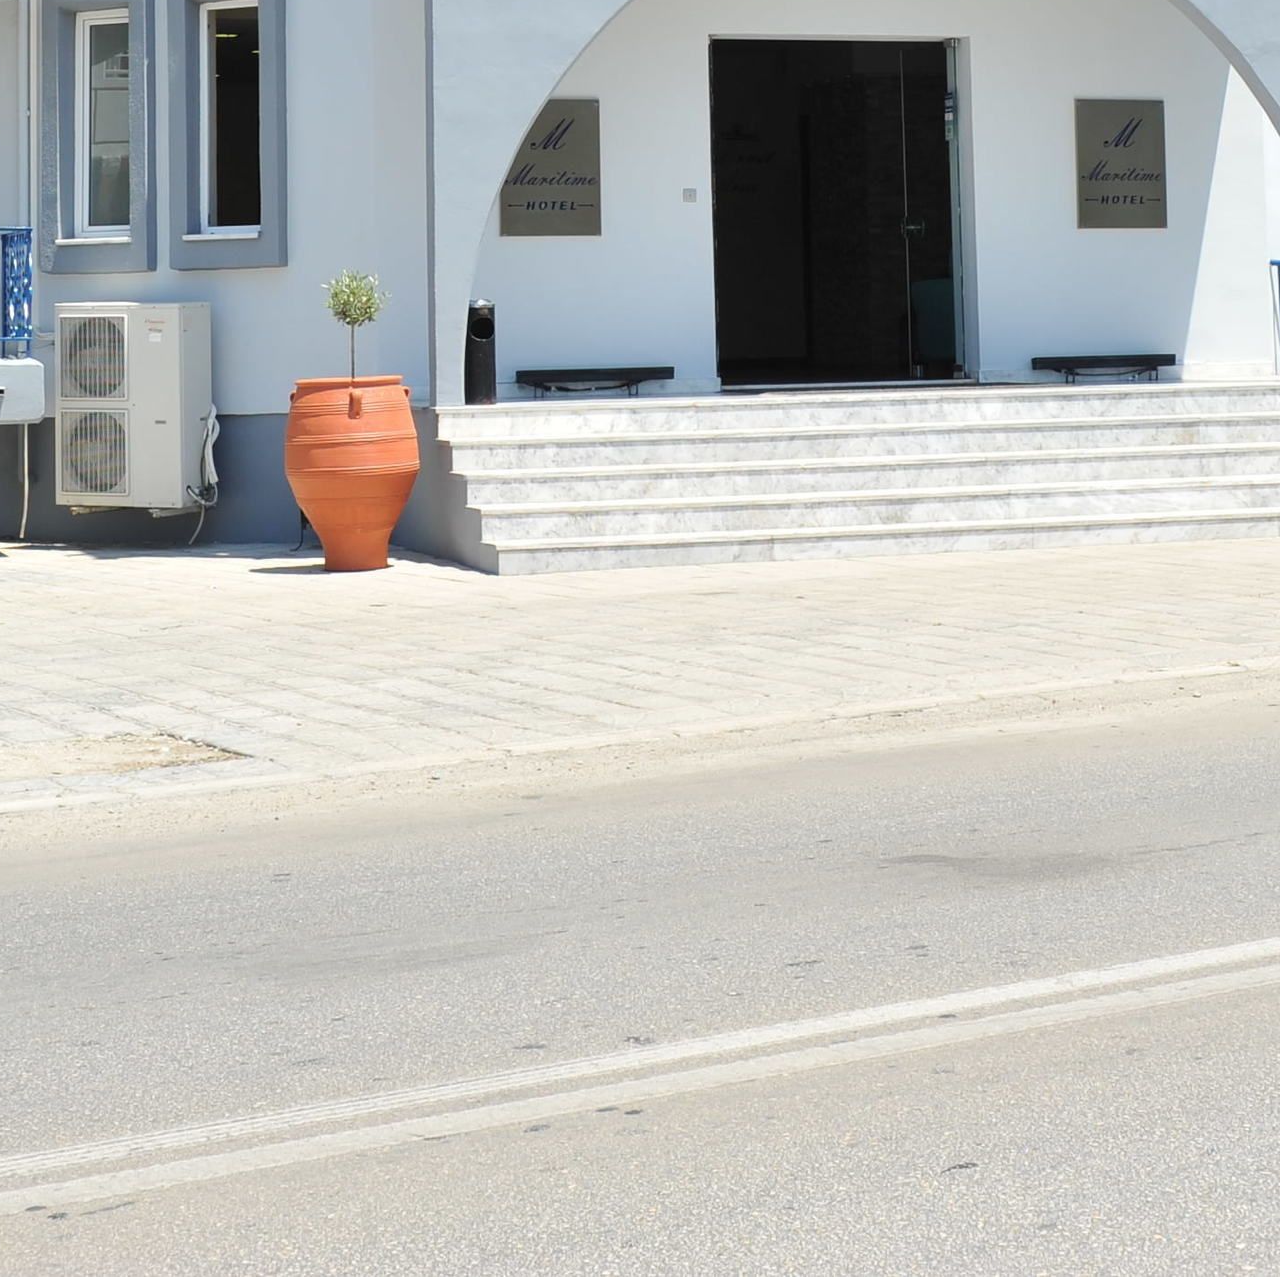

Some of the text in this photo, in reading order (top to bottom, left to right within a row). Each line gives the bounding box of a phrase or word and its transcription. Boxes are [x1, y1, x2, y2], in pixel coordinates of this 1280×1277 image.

[530, 118, 575, 150] M
[1103, 117, 1143, 148] M
[504, 163, 597, 186] Maritime
[1081, 159, 1161, 181] Maritime
[526, 201, 577, 211] HOTEL
[1100, 195, 1145, 205] HOTEL
